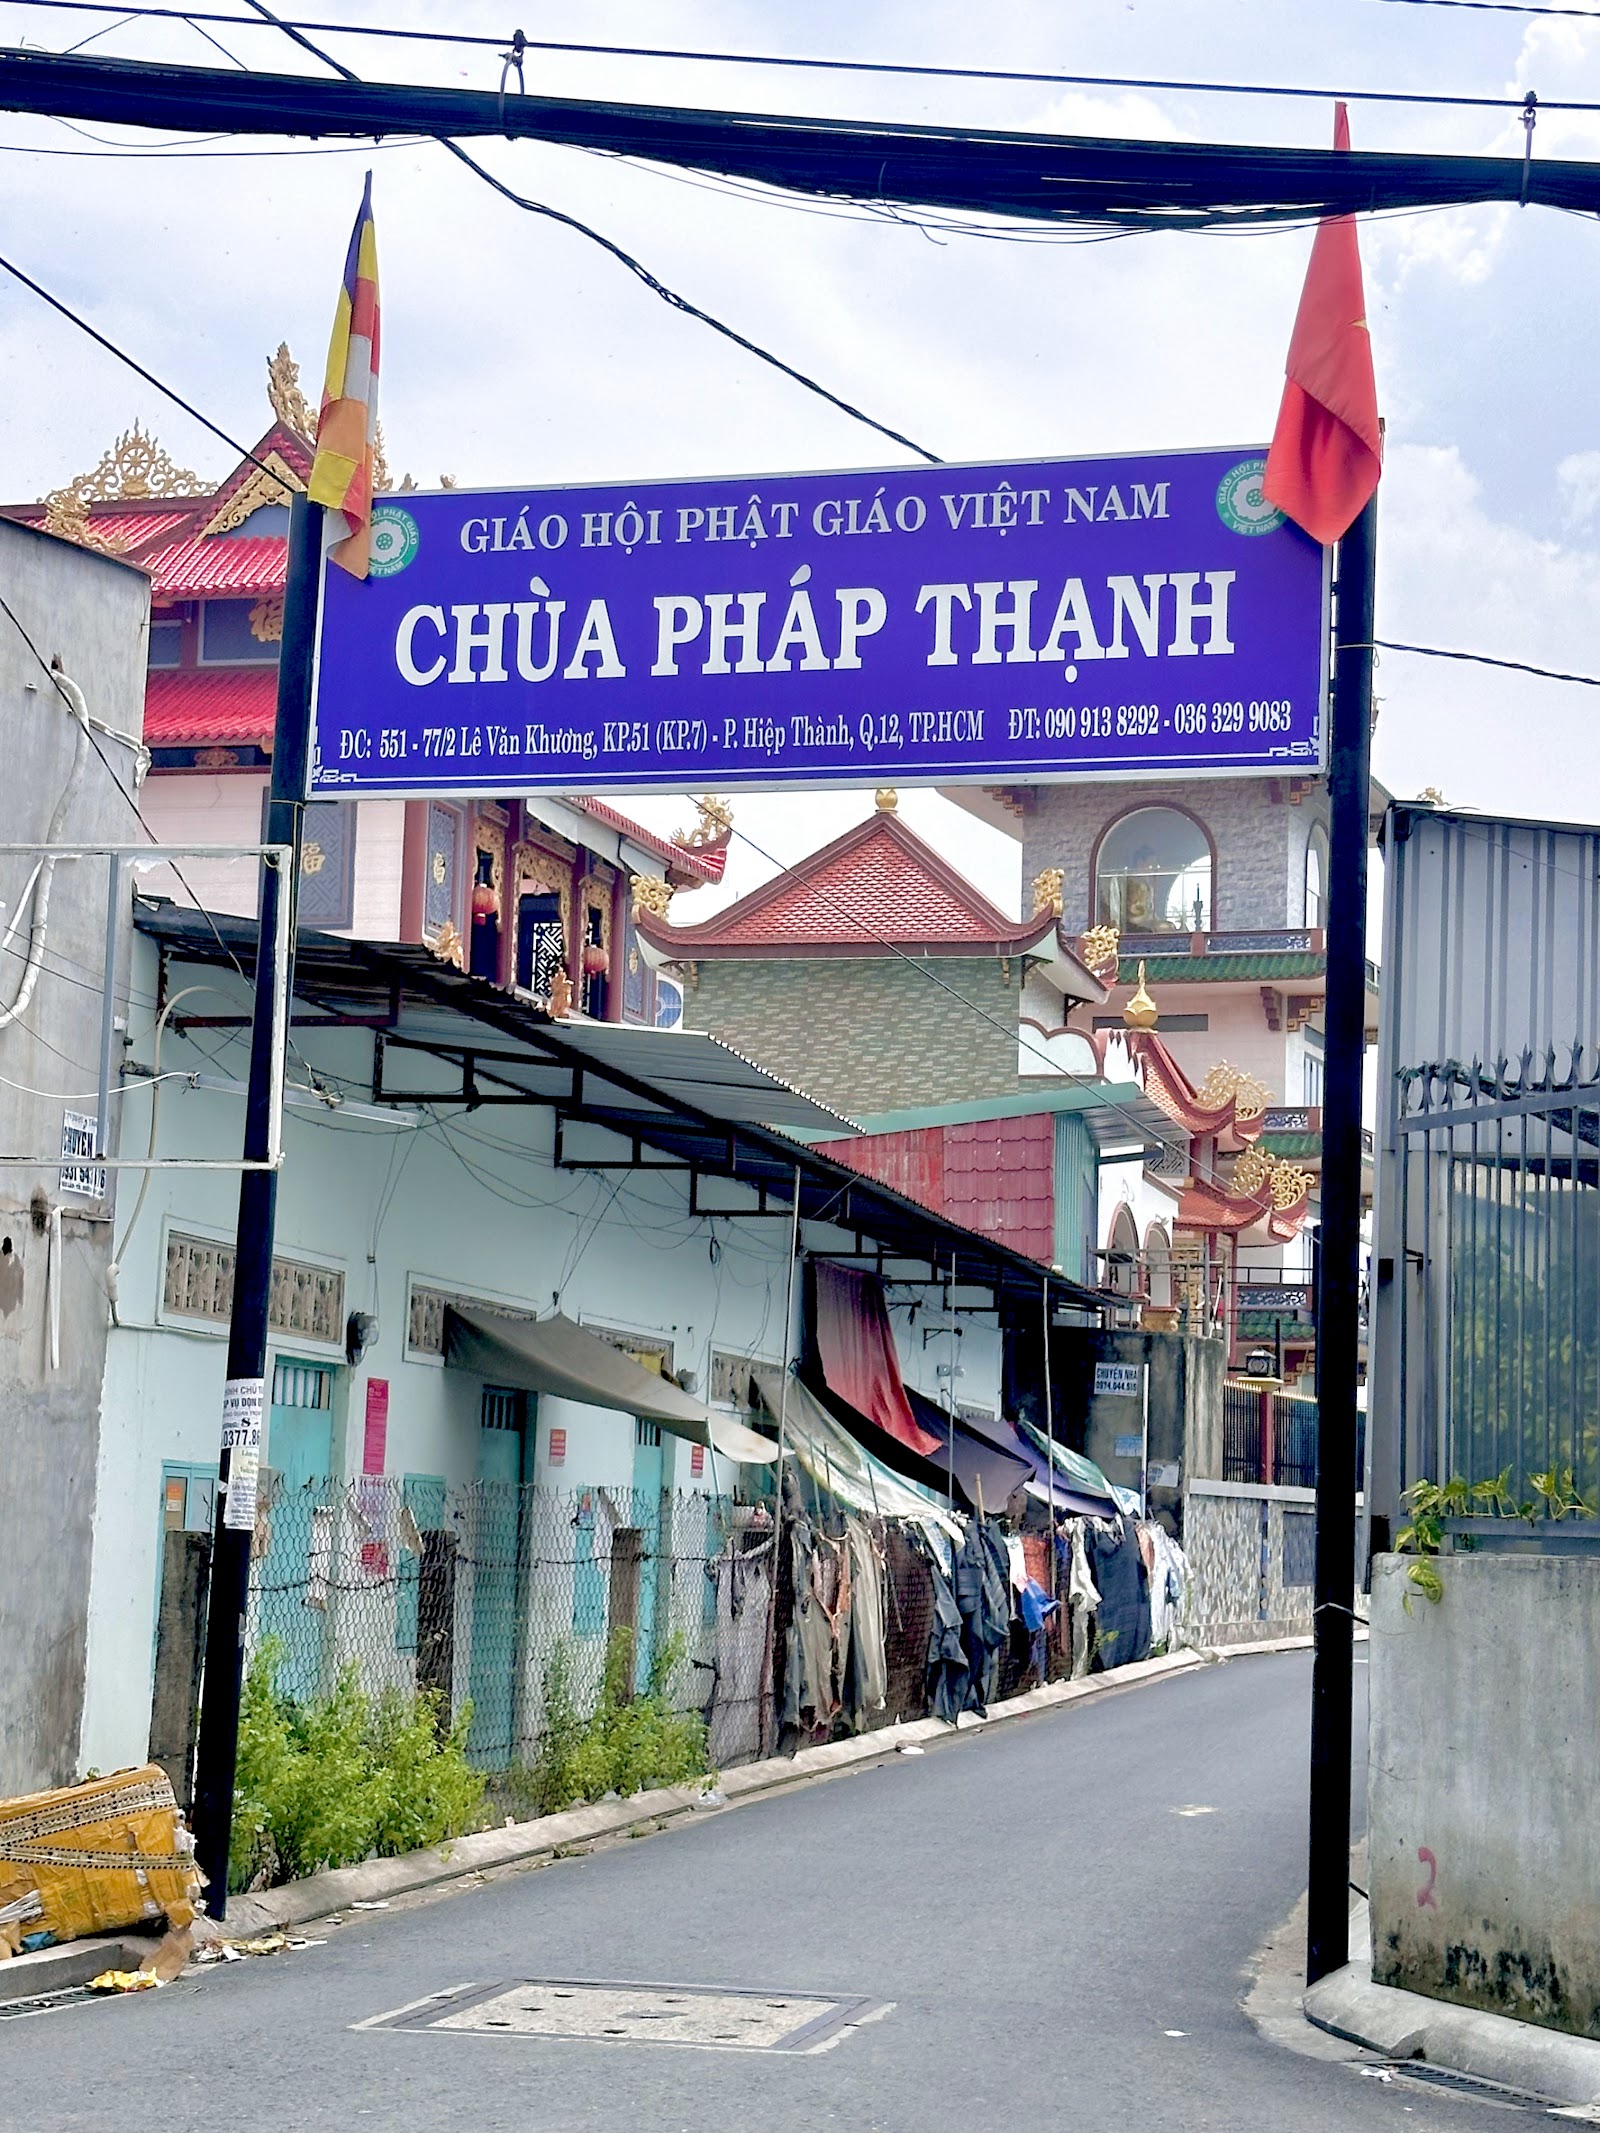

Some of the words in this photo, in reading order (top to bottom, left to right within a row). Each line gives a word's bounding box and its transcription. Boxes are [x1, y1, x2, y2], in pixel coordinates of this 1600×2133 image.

[461, 505, 568, 553] GIÁO
[580, 501, 662, 554] HỘI
[676, 494, 798, 548] PHẬT
[813, 487, 926, 536] GIÁO
[940, 481, 1050, 536] VIỆT
[1063, 482, 1171, 523] NAM
[395, 576, 627, 686] CHÙA
[651, 563, 887, 677] PHÁP
[914, 570, 1237, 683] THẠNH
[340, 729, 371, 758] ĐC:
[380, 729, 407, 758] 551
[423, 727, 455, 757] 77/2
[460, 726, 482, 756] Lê
[486, 725, 520, 755] Văn
[525, 724, 597, 760] Khương,
[603, 722, 650, 752] KP.51
[656, 720, 707, 754] (KP.7)
[723, 718, 738, 749] P.
[743, 717, 785, 756] Hiệp
[791, 715, 854, 752] Thành,
[859, 713, 904, 752] Q.12,
[909, 710, 984, 742] TP.HCM
[1008, 708, 1040, 740] ĐT:
[1045, 707, 1076, 738] 090
[1081, 706, 1112, 738] 913
[1116, 704, 1159, 736] 8292
[1174, 703, 1206, 734] 036
[1211, 702, 1244, 733] 329
[1249, 700, 1292, 731] 9083
